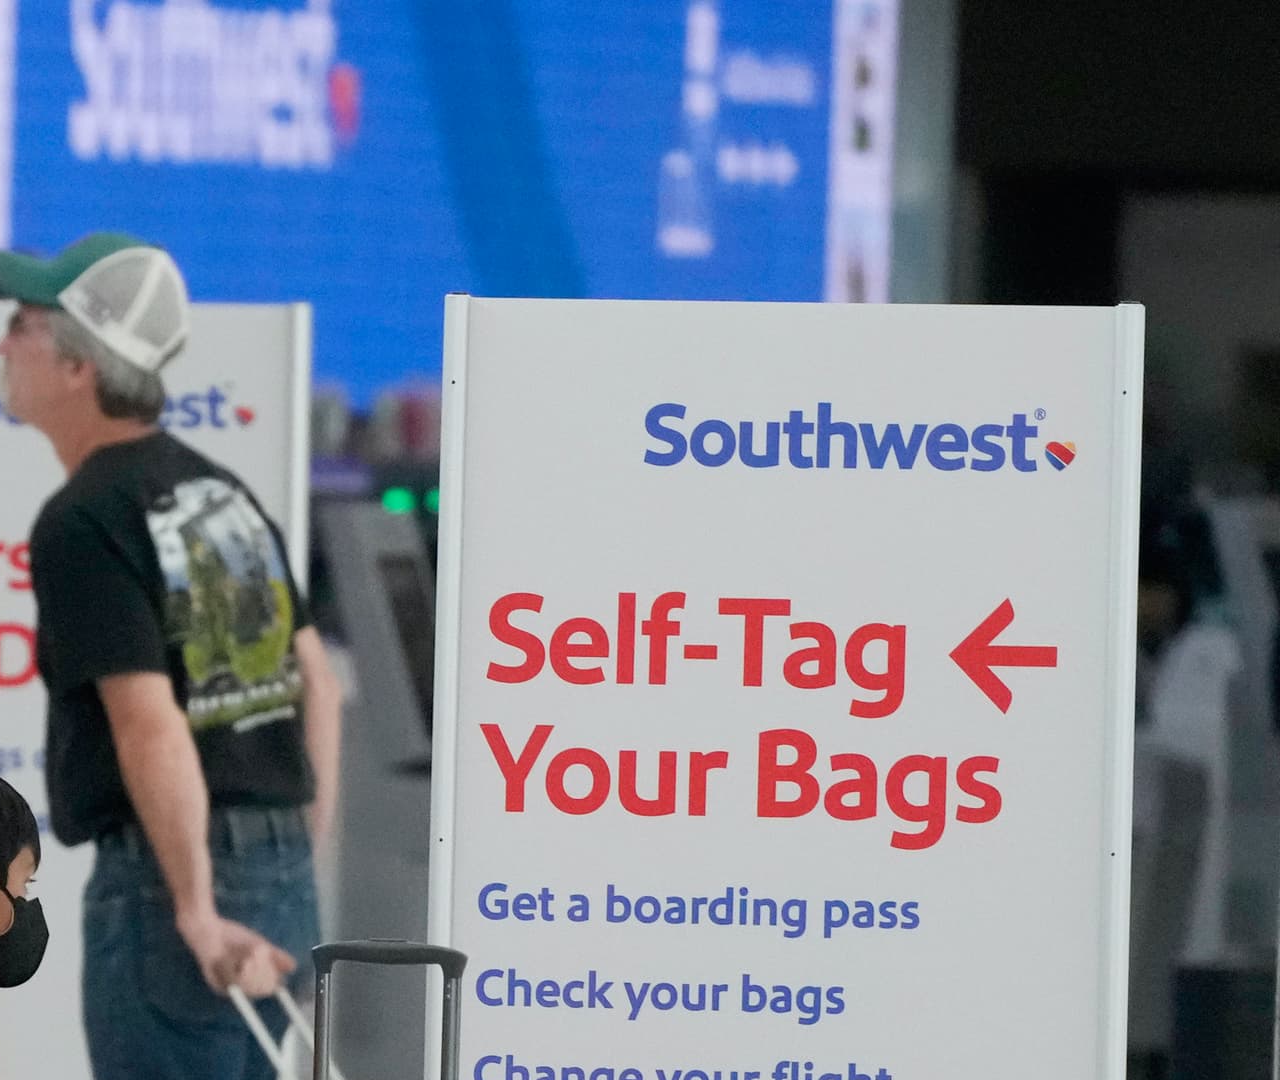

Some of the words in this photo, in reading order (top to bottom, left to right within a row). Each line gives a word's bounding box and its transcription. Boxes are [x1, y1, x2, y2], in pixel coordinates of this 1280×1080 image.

[486, 591, 906, 719] Self-Tag
[479, 723, 729, 817] Your
[756, 728, 1002, 850] Bags
[477, 882, 554, 923] Get
[567, 892, 589, 923] a
[605, 884, 807, 939] boarding
[823, 898, 920, 939] pass
[475, 968, 613, 1009] Check
[624, 977, 728, 1021] your
[741, 974, 846, 1026] bags
